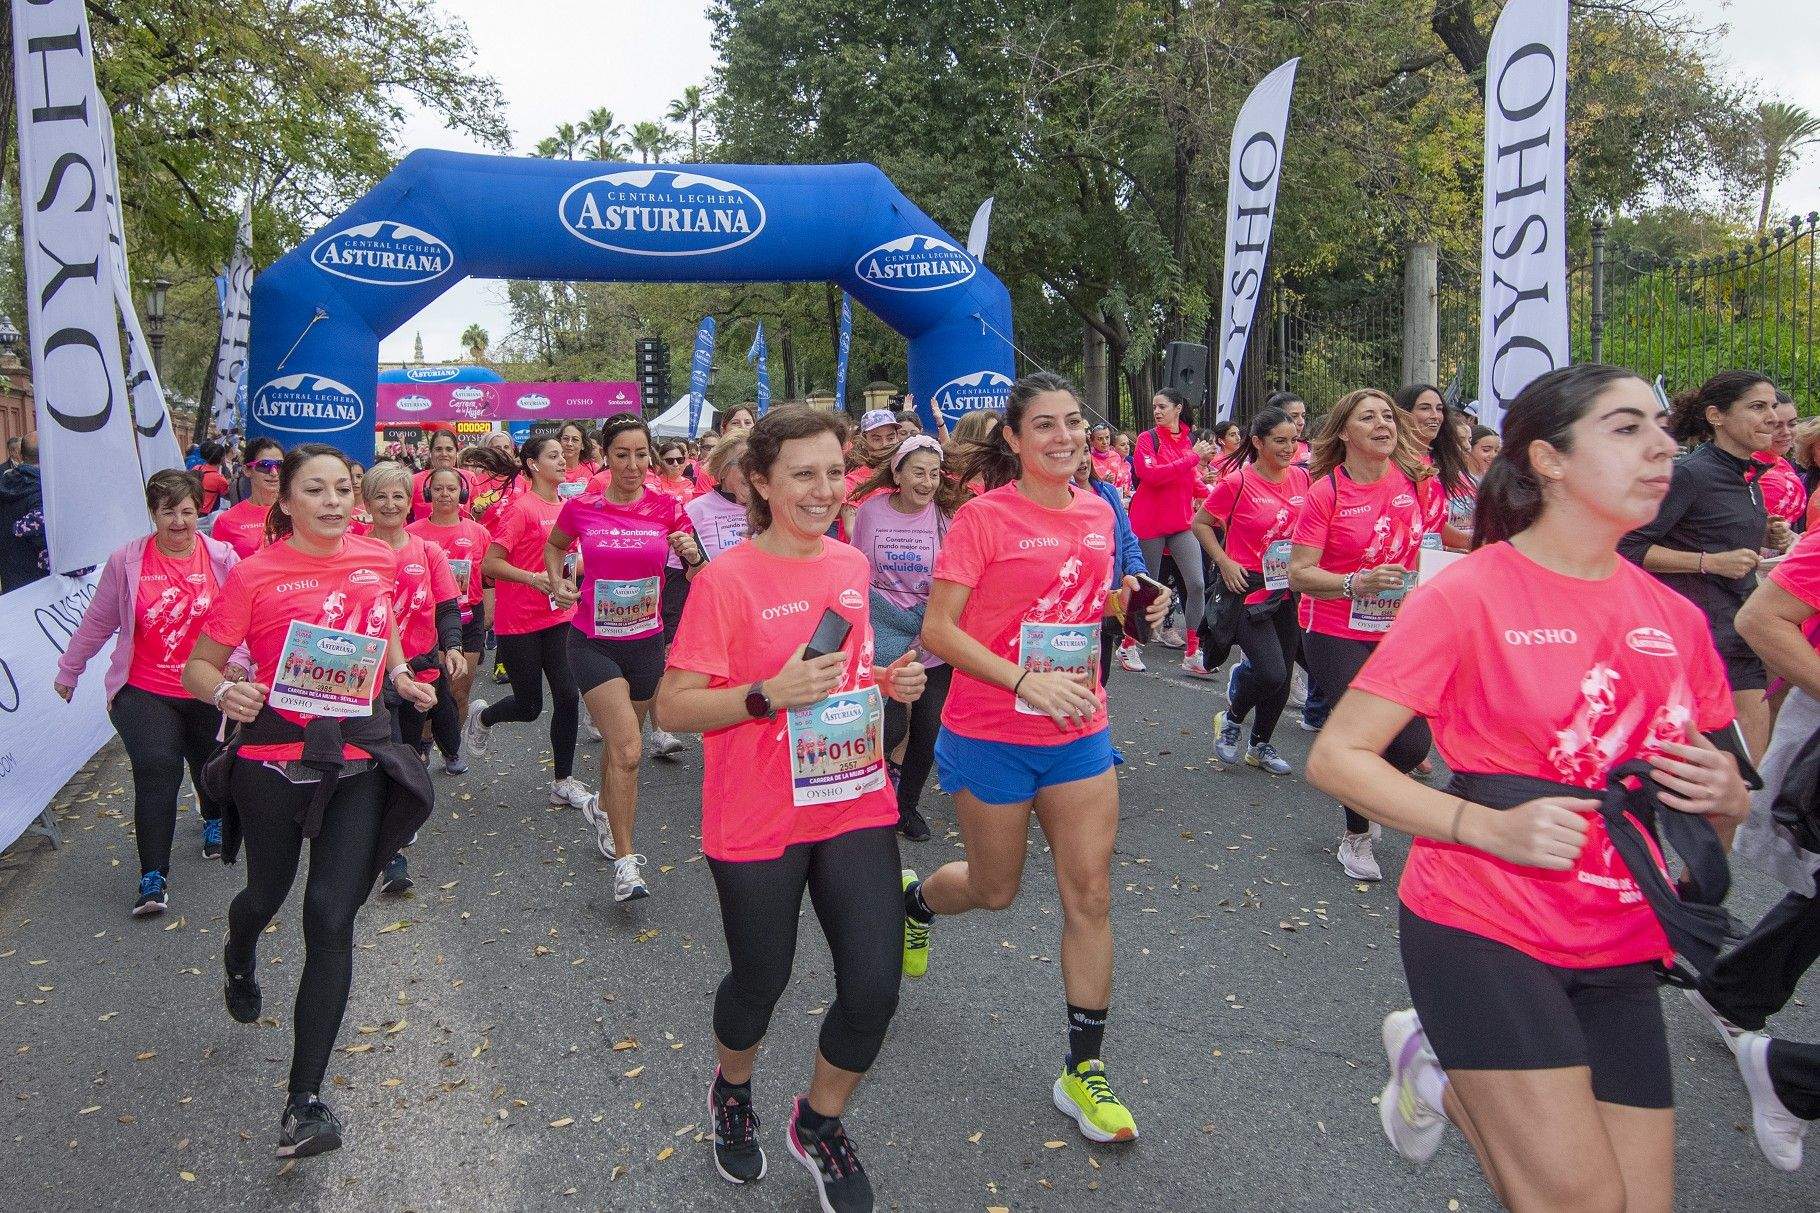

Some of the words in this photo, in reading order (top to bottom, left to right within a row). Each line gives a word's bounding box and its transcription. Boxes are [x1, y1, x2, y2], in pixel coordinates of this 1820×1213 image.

[607, 191, 673, 203] CENTRAL
[679, 194, 744, 205] LECHERA
[28, 0, 112, 433] OYSH
[575, 192, 751, 233] ASTURIANA
[1492, 42, 1556, 411] OYSHO
[344, 240, 392, 249] CENTRAL
[395, 243, 442, 254] LECHERA
[320, 242, 443, 272] ASTURIANA
[885, 253, 926, 262] CENTRAL
[865, 258, 971, 279] ASTURIANA
[411, 369, 456, 378] ASTURIANA
[272, 392, 312, 400] CENTRAL
[315, 394, 355, 403] LECHERA
[566, 398, 594, 406] OYSHO
[940, 391, 1009, 411] ASTURIA
[257, 394, 357, 420] ASTURIANA
[1340, 504, 1372, 517] OYSHO
[586, 528, 609, 536] Sports
[620, 528, 660, 536] Santander
[1019, 537, 1059, 549] OYSHO
[885, 551, 922, 561] Tod@s
[878, 562, 929, 573] incluid@s
[276, 578, 319, 593] OYSHO
[761, 600, 809, 620] OYSHO
[1504, 628, 1578, 645] OYSHO
[320, 640, 354, 654] ASTURIANA
[311, 666, 347, 684] 016
[280, 696, 313, 708] OYSHO
[824, 707, 862, 722] ASTURIANA
[829, 738, 866, 760] 016
[839, 760, 858, 771] 2557
[809, 776, 834, 784] CARRERA
[806, 786, 843, 799] OYSHO
